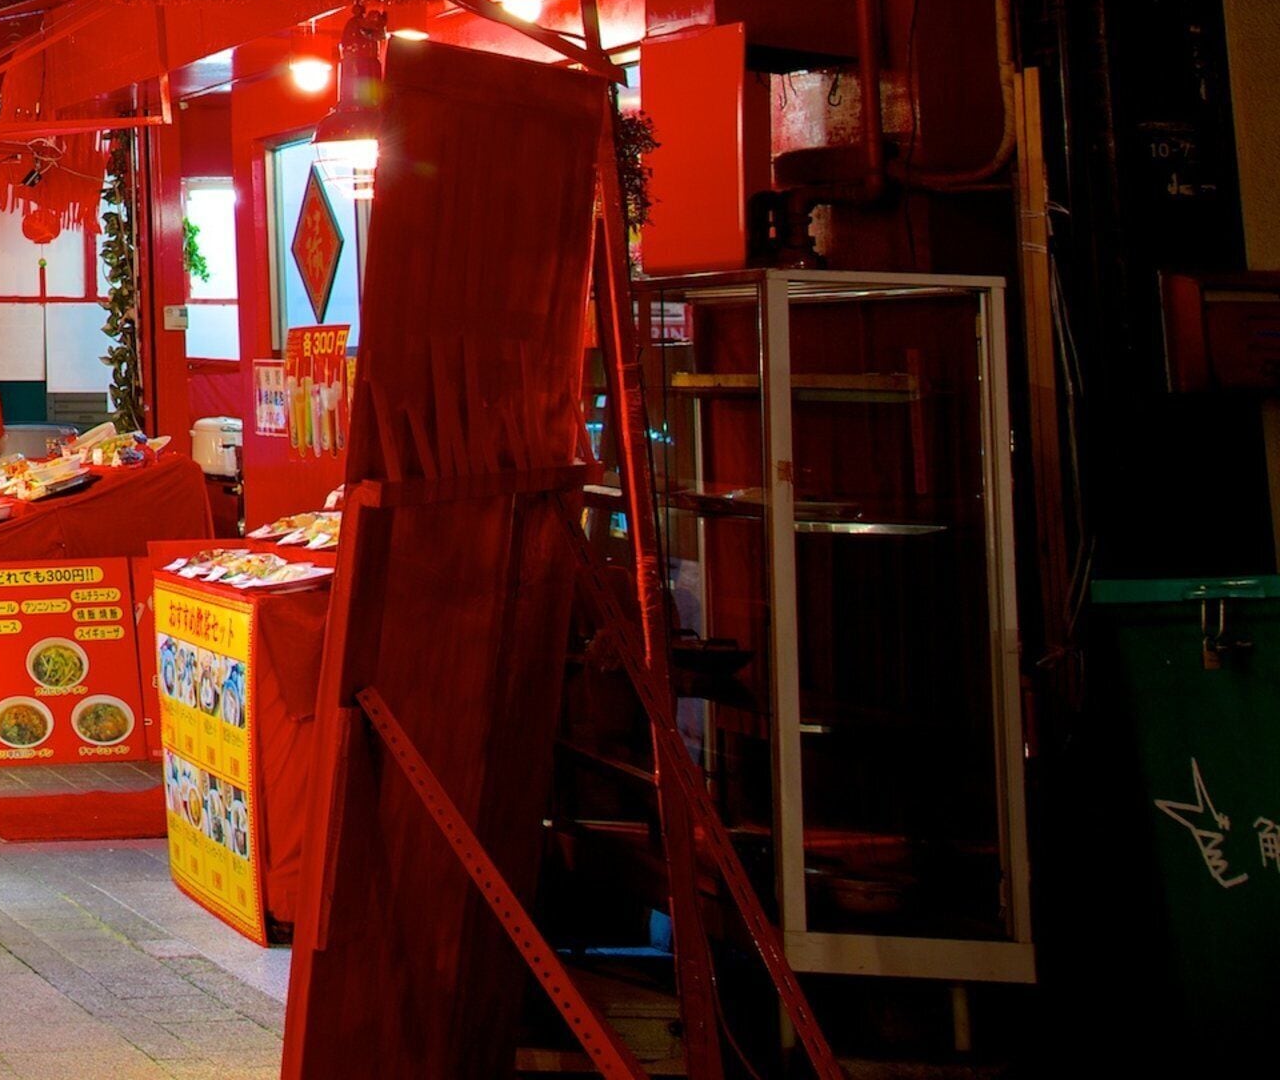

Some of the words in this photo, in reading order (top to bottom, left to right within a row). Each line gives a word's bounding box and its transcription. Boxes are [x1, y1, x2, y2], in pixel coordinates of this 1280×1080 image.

[77, 626, 121, 639] スイギョーザ
